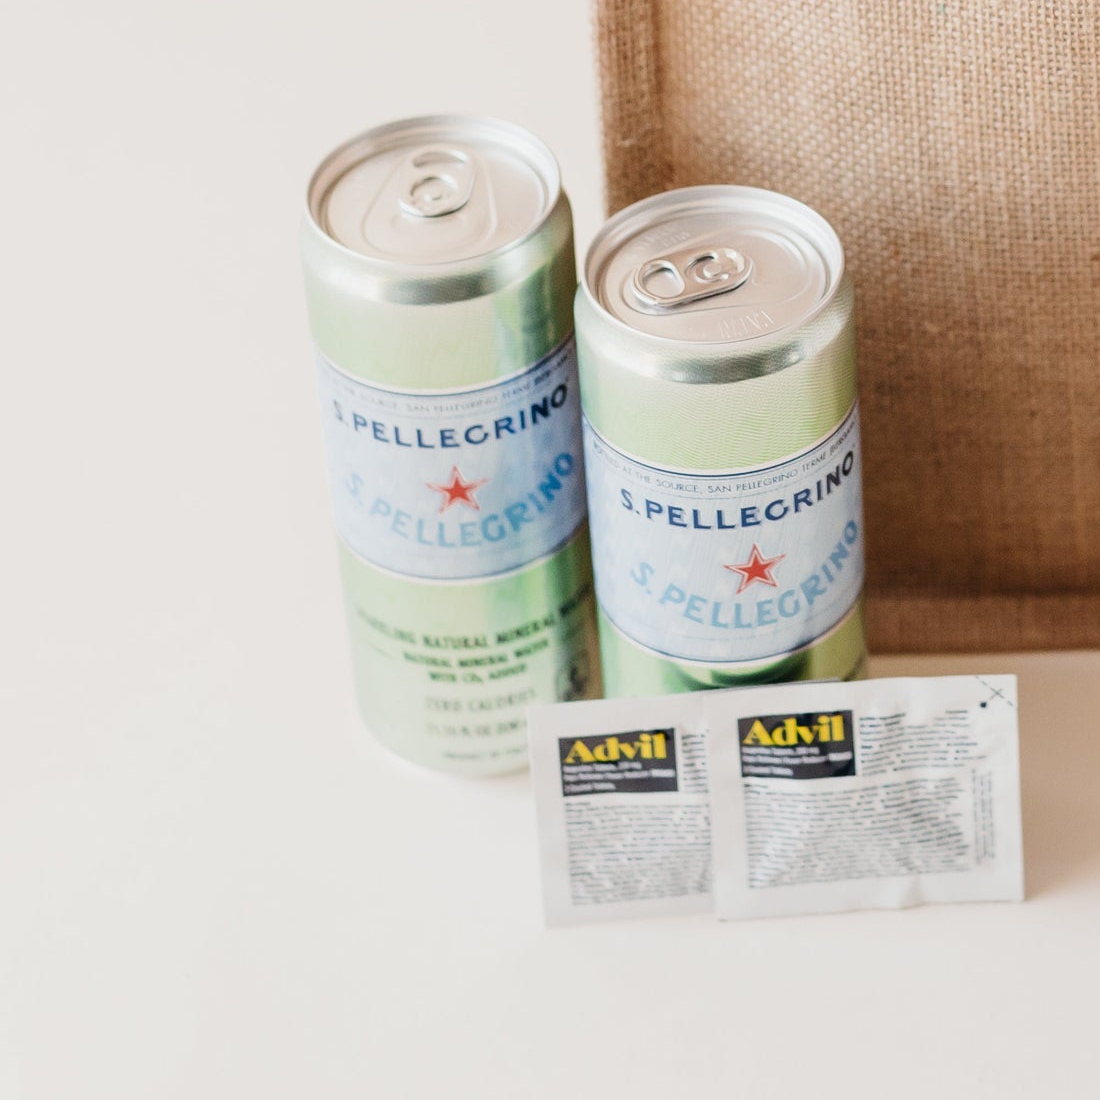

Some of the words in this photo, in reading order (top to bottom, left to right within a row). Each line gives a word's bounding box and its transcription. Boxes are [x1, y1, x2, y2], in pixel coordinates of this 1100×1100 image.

[656, 479, 703, 495] SOURCE,
[707, 483, 732, 494] SAN
[736, 469, 799, 491] PELLEGRINO
[423, 634, 488, 649] NATURAL
[742, 714, 846, 747] Advil
[563, 732, 668, 764] Advil
